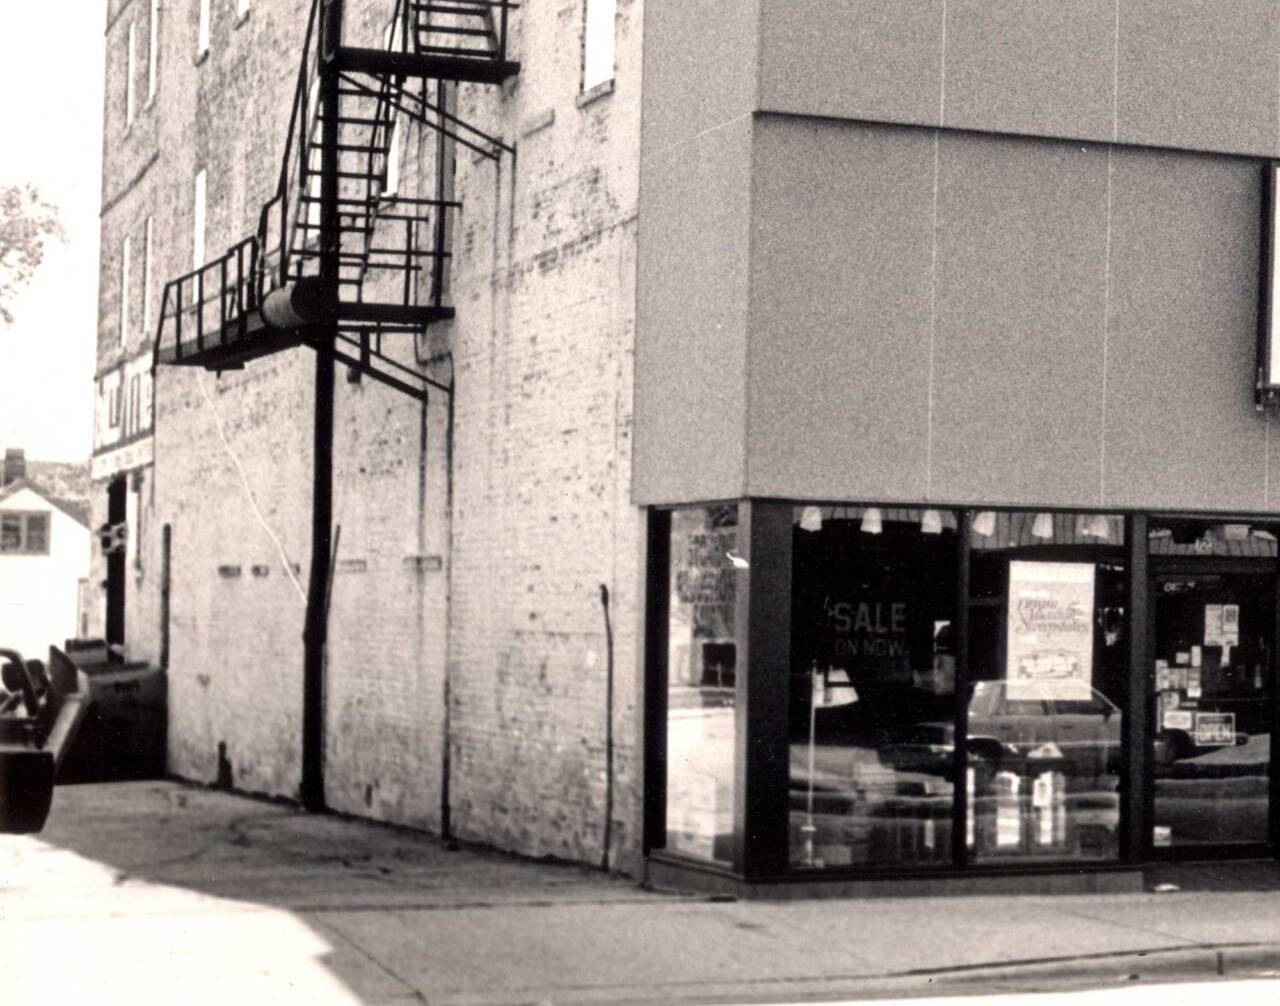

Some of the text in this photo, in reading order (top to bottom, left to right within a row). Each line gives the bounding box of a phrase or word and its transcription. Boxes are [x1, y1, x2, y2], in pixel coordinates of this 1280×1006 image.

[833, 601, 907, 633] SALE
[835, 638, 905, 658] ON NOW
